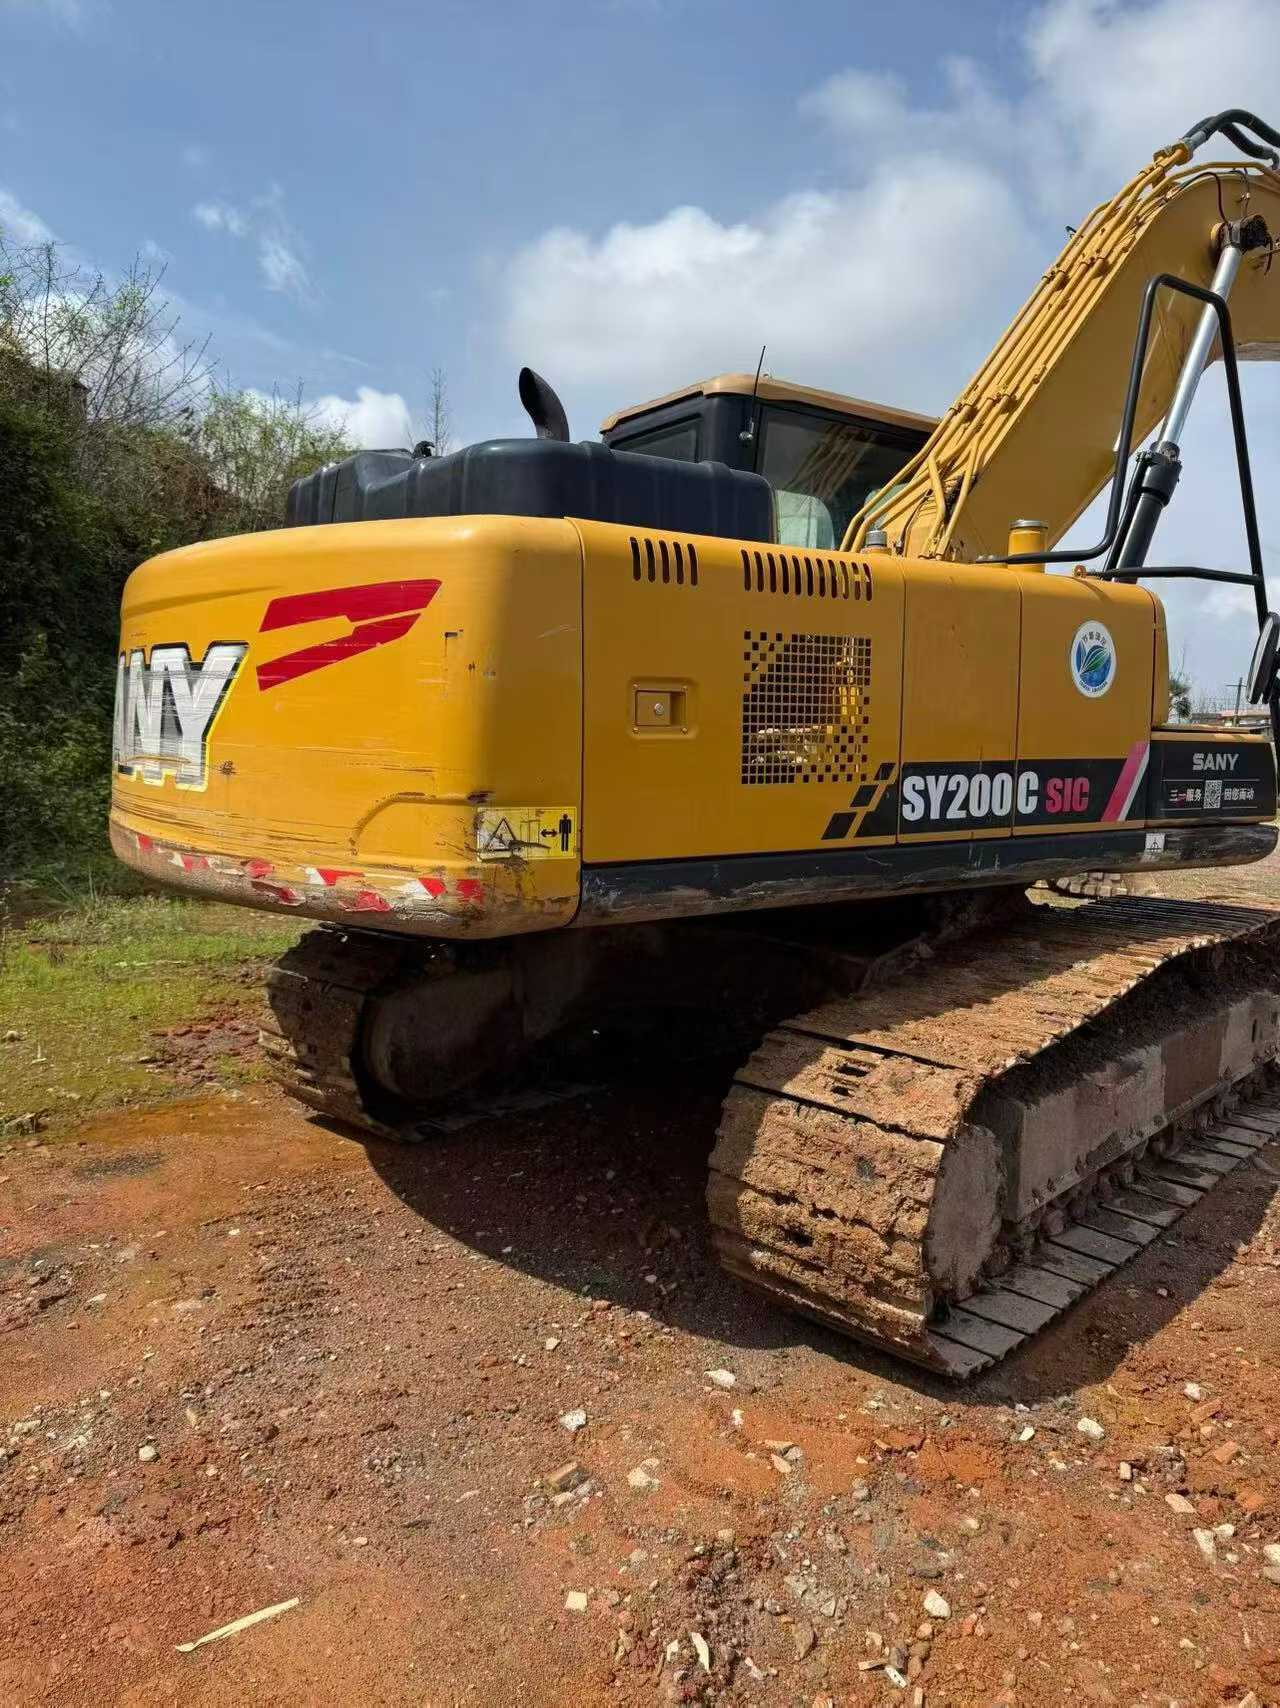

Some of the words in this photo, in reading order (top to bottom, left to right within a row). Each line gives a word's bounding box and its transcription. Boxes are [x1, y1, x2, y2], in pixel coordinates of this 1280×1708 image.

[113, 641, 249, 790] NY
[1192, 753, 1239, 771] SANY
[902, 771, 1039, 821] SY200C
[1169, 788, 1202, 802] 三一服务
